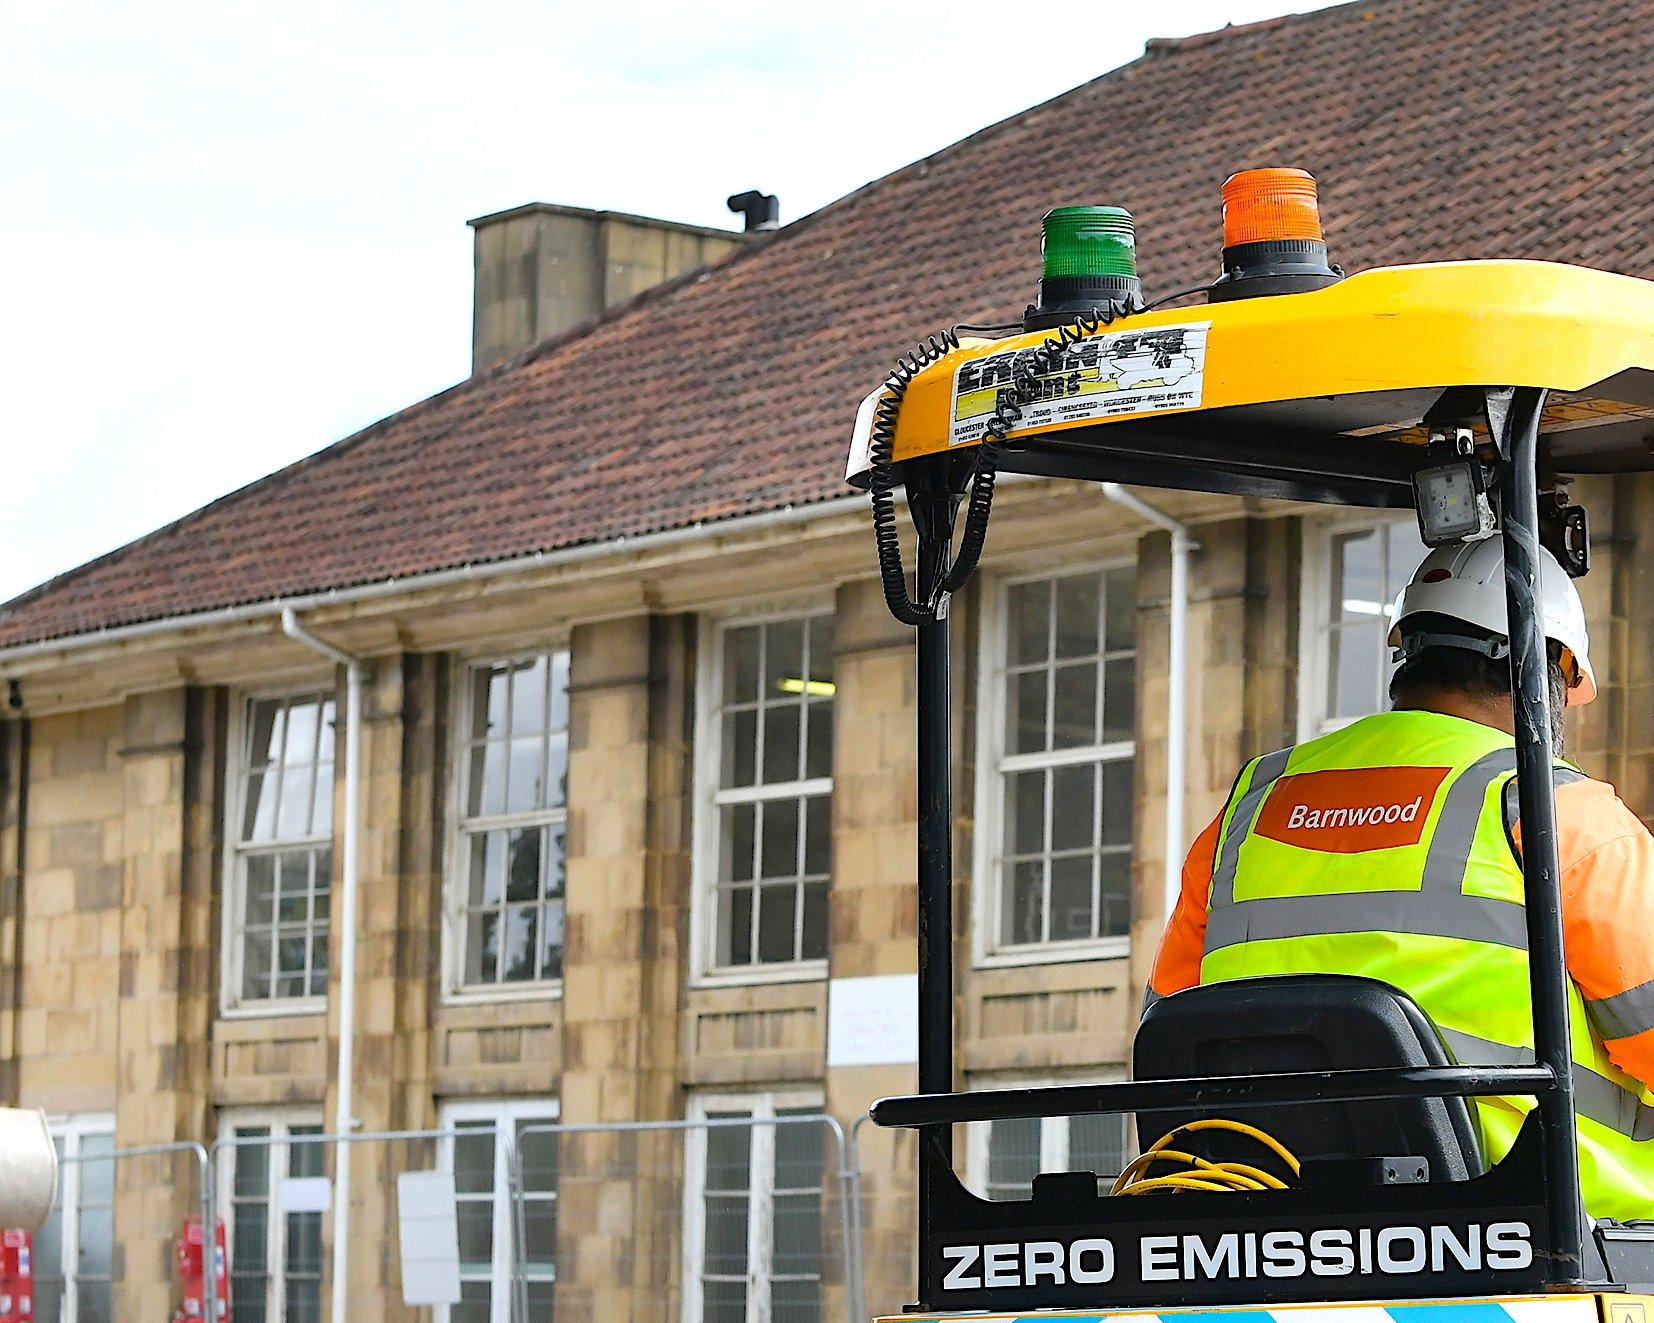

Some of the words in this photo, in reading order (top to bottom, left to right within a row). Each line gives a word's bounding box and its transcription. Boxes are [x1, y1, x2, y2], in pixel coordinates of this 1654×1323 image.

[1287, 796, 1422, 829] Barnwood
[943, 1238, 1115, 1290] ZERO
[1141, 1222, 1534, 1282] EMISSIONS
